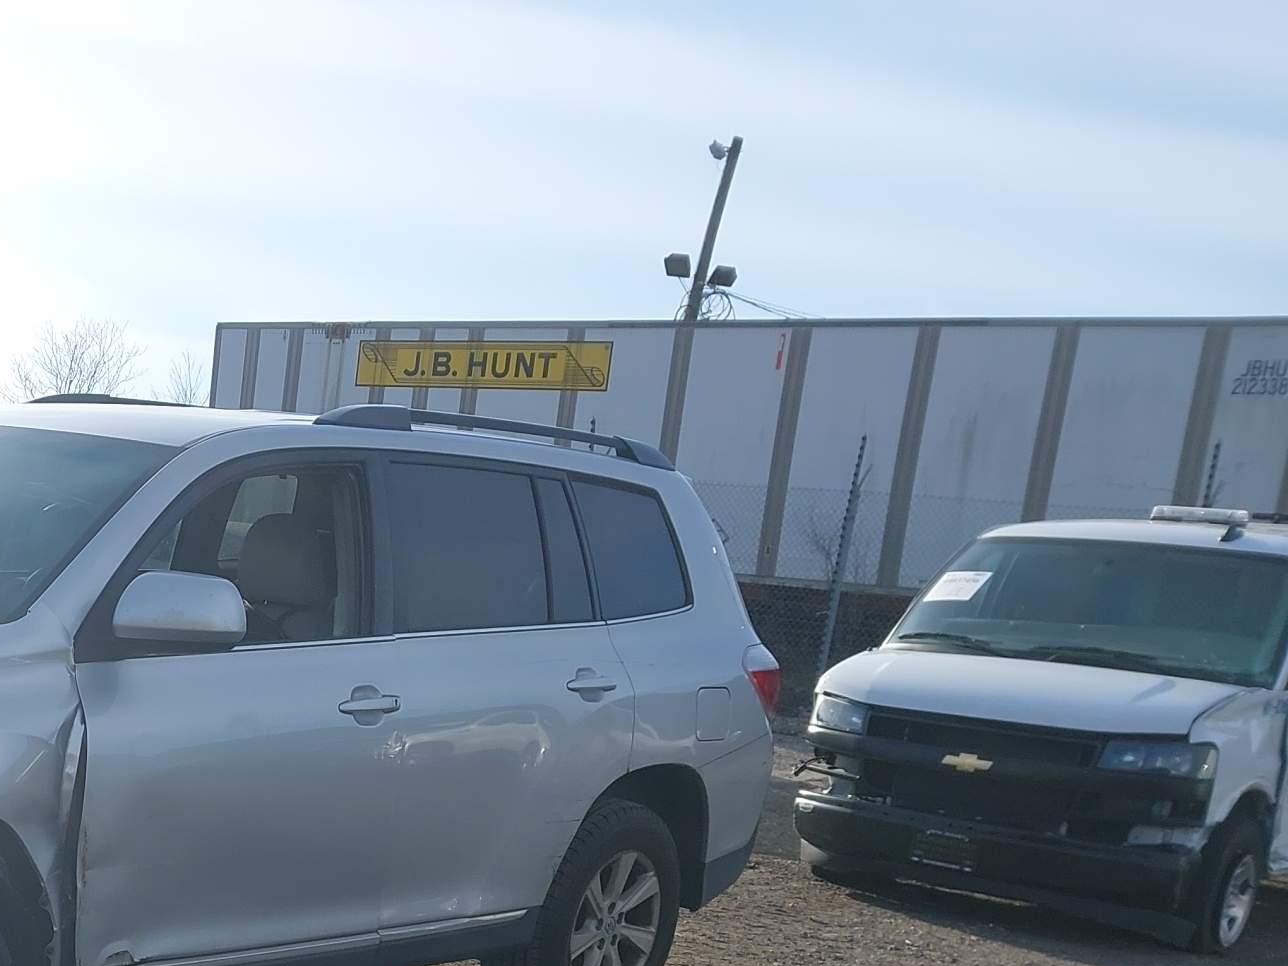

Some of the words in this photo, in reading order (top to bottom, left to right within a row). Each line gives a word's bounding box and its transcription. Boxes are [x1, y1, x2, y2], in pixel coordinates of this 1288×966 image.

[403, 351, 458, 378] J.B.
[466, 351, 557, 379] HUNT
[1240, 359, 1288, 377] JBHU
